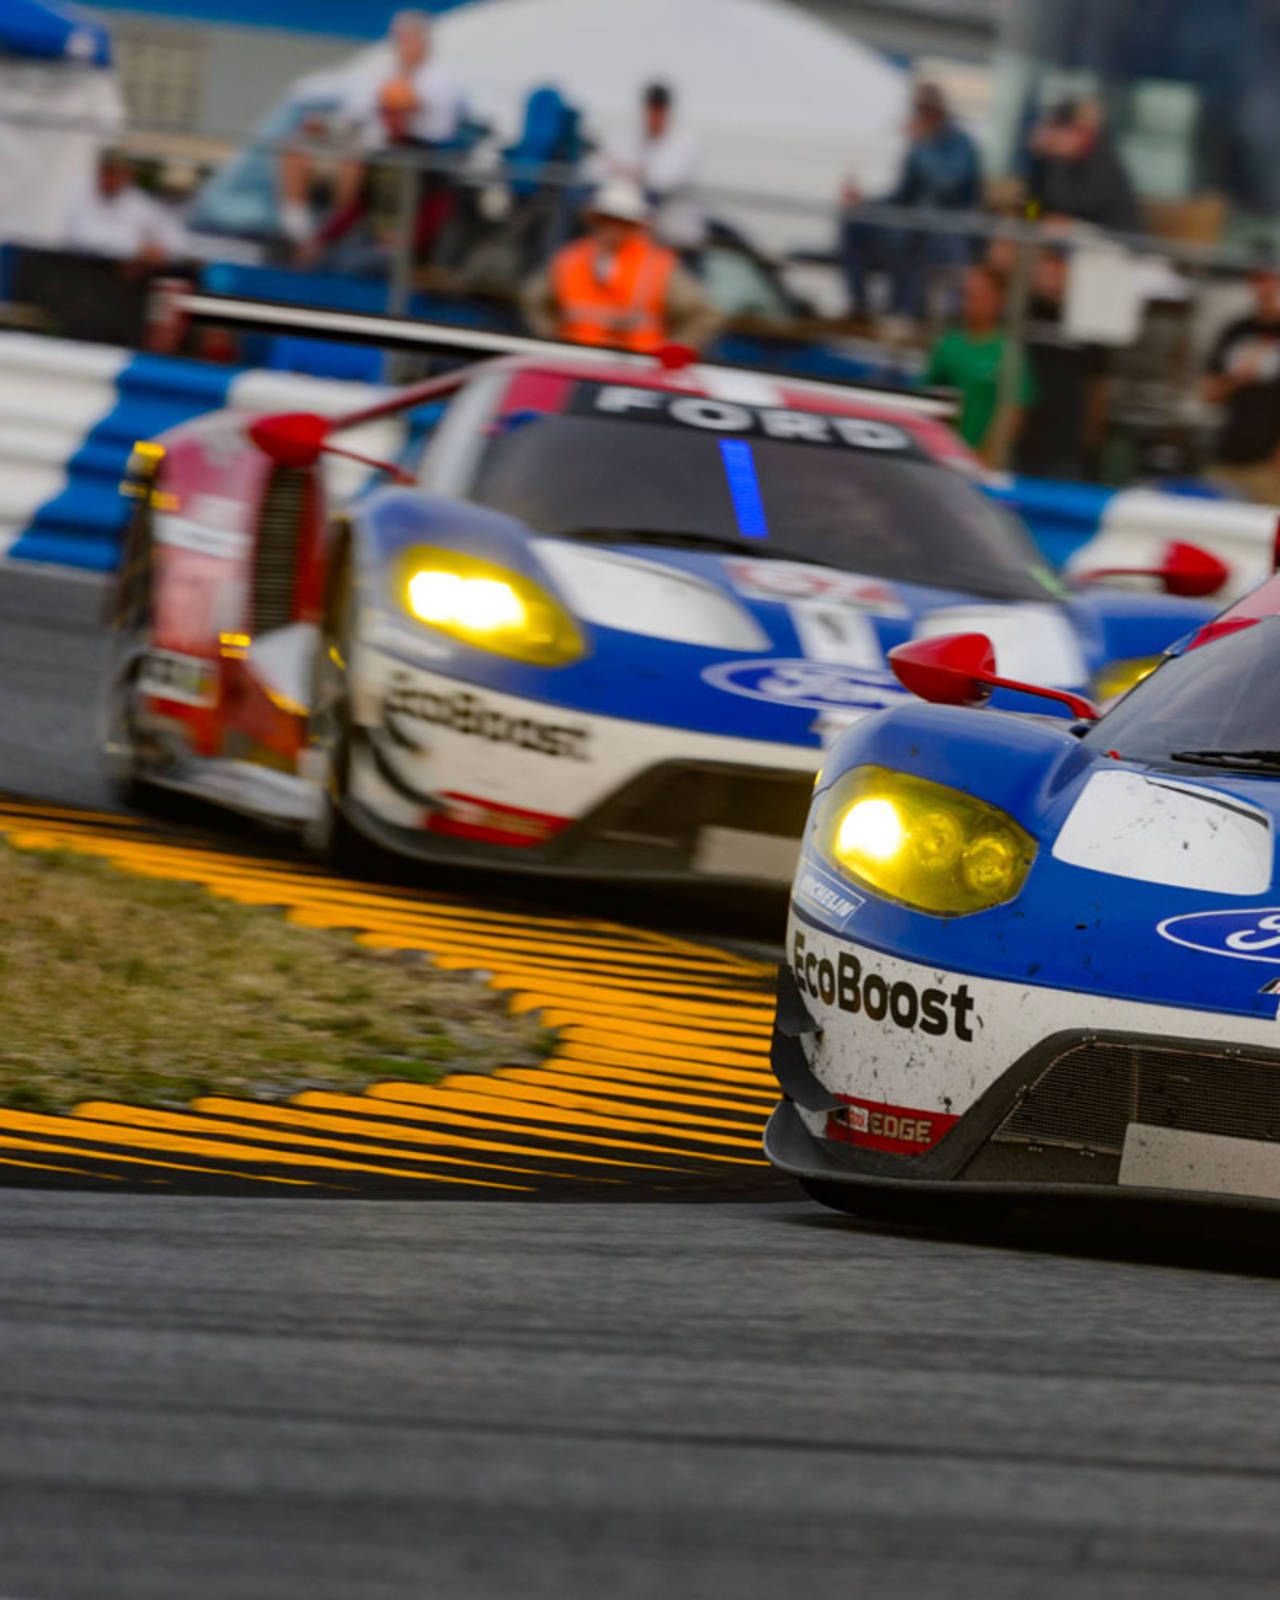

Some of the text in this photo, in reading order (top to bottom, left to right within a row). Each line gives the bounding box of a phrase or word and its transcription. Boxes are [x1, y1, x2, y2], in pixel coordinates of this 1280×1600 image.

[595, 383, 910, 450] FORD
[793, 930, 975, 1043] EcoBoost
[870, 1111, 933, 1144] EDGE
